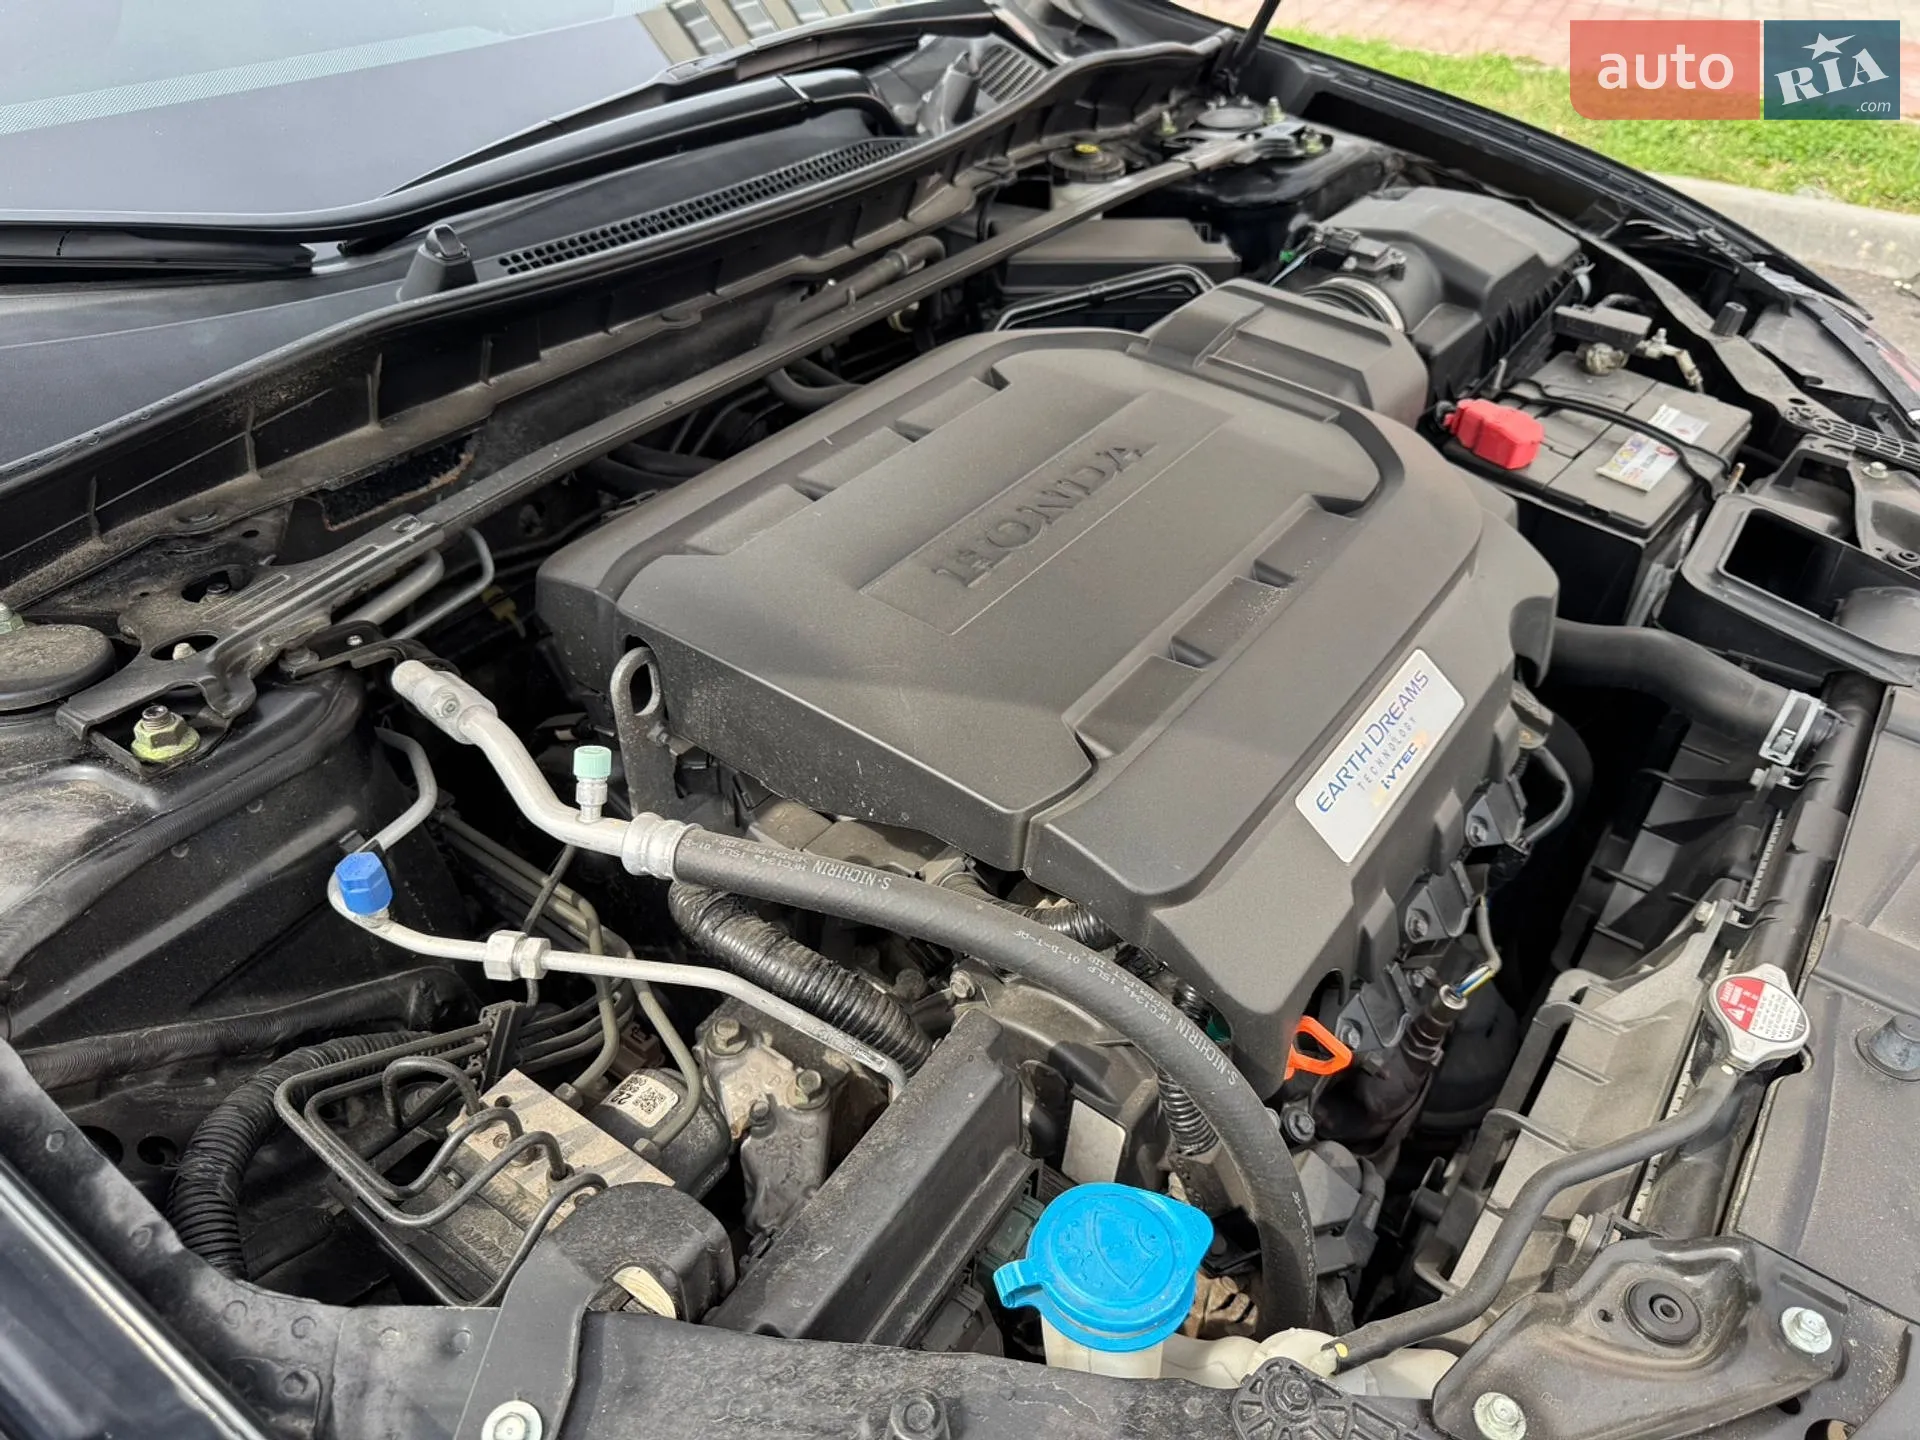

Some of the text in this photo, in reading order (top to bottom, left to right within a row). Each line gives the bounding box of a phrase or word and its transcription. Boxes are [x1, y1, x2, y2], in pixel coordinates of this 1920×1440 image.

[930, 444, 1157, 588] HONDA
[1316, 670, 1429, 813] EARTH DREAMS
[1357, 716, 1418, 791] TECHNOLOGY
